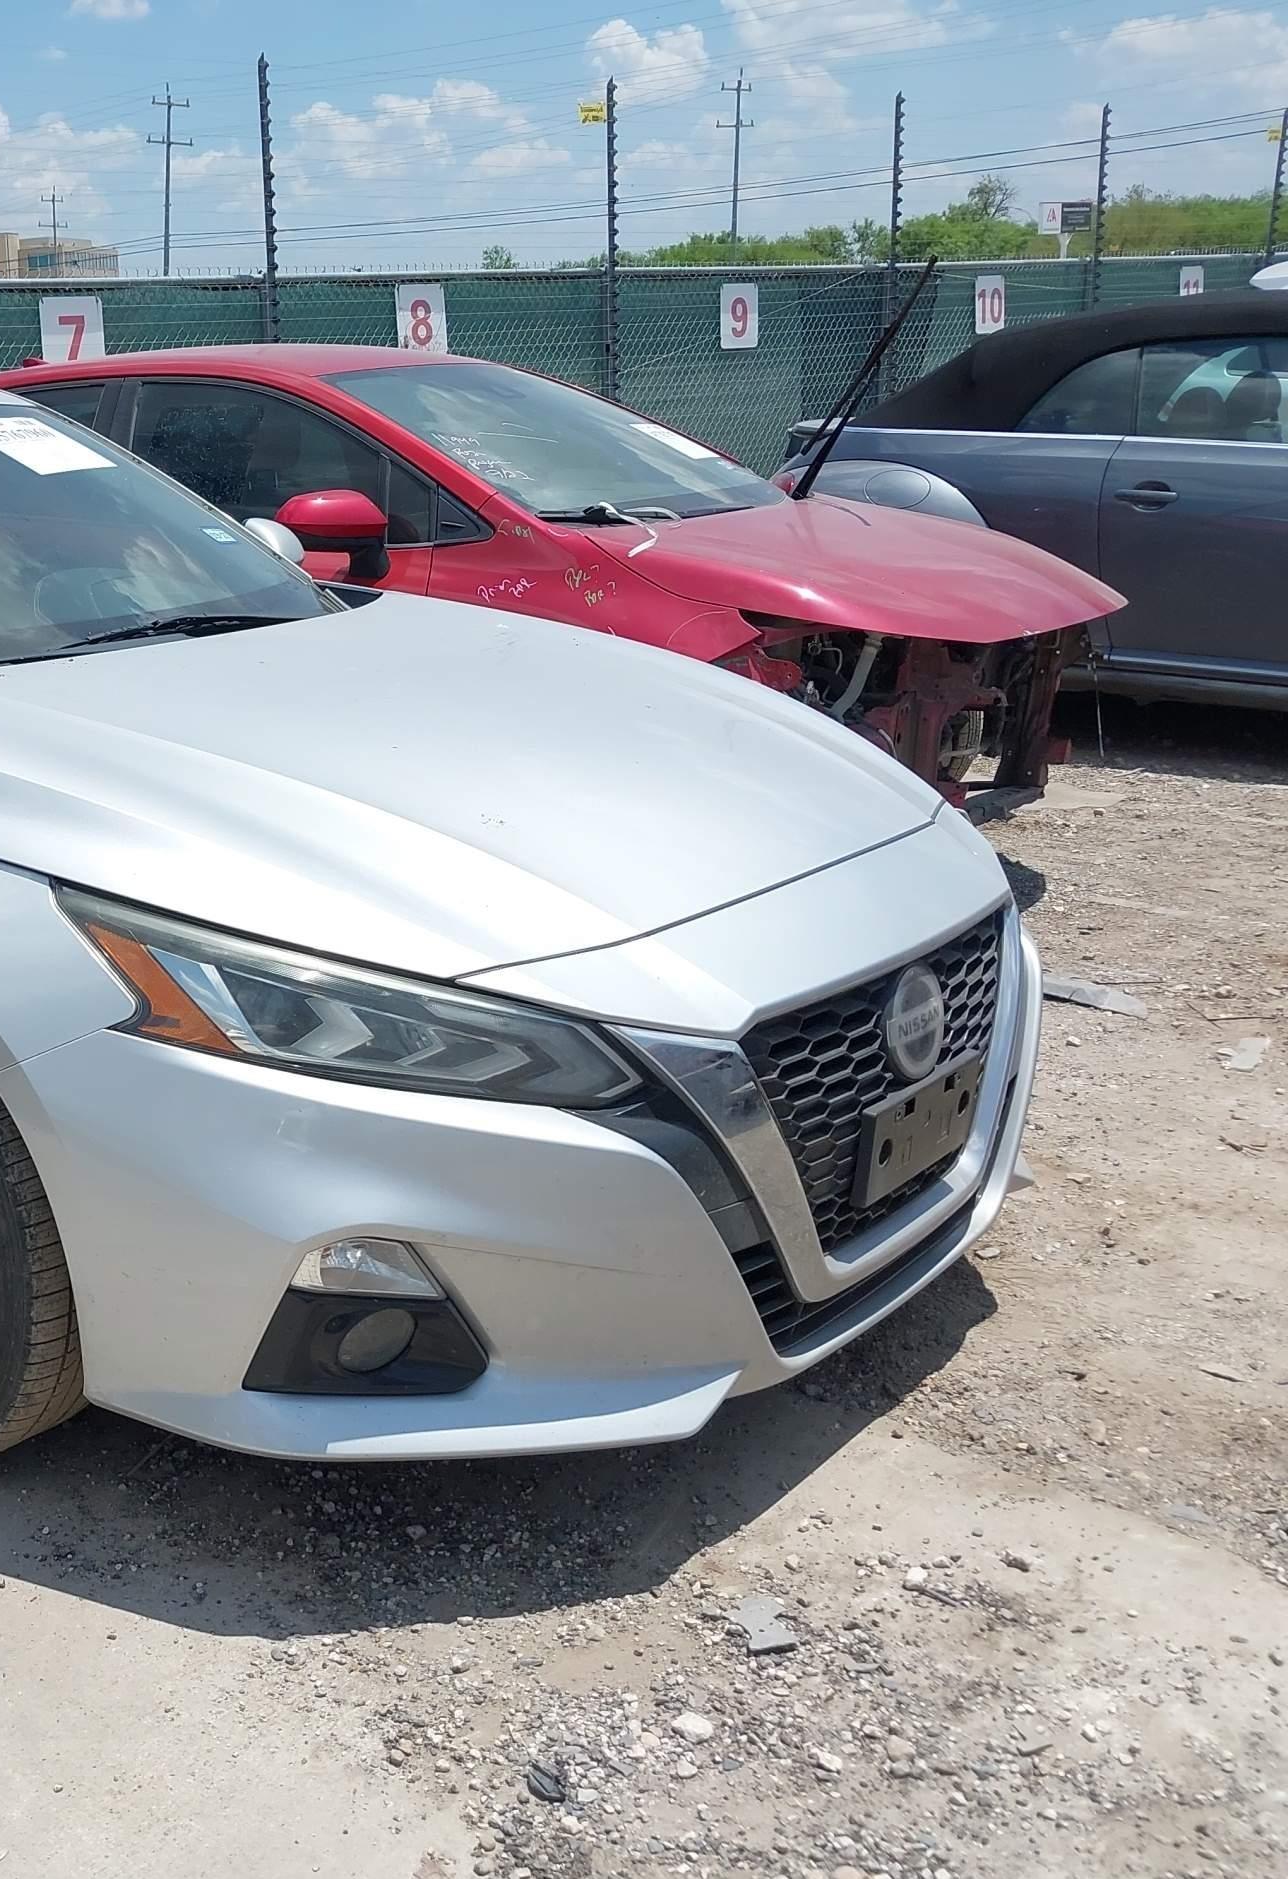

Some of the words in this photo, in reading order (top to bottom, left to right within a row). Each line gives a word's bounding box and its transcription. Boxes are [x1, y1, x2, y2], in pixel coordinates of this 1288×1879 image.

[410, 299, 433, 346] 8
[731, 296, 748, 338] 9
[977, 287, 1003, 324] 10
[58, 315, 85, 361] 7
[898, 1005, 940, 1039] NISSAN
